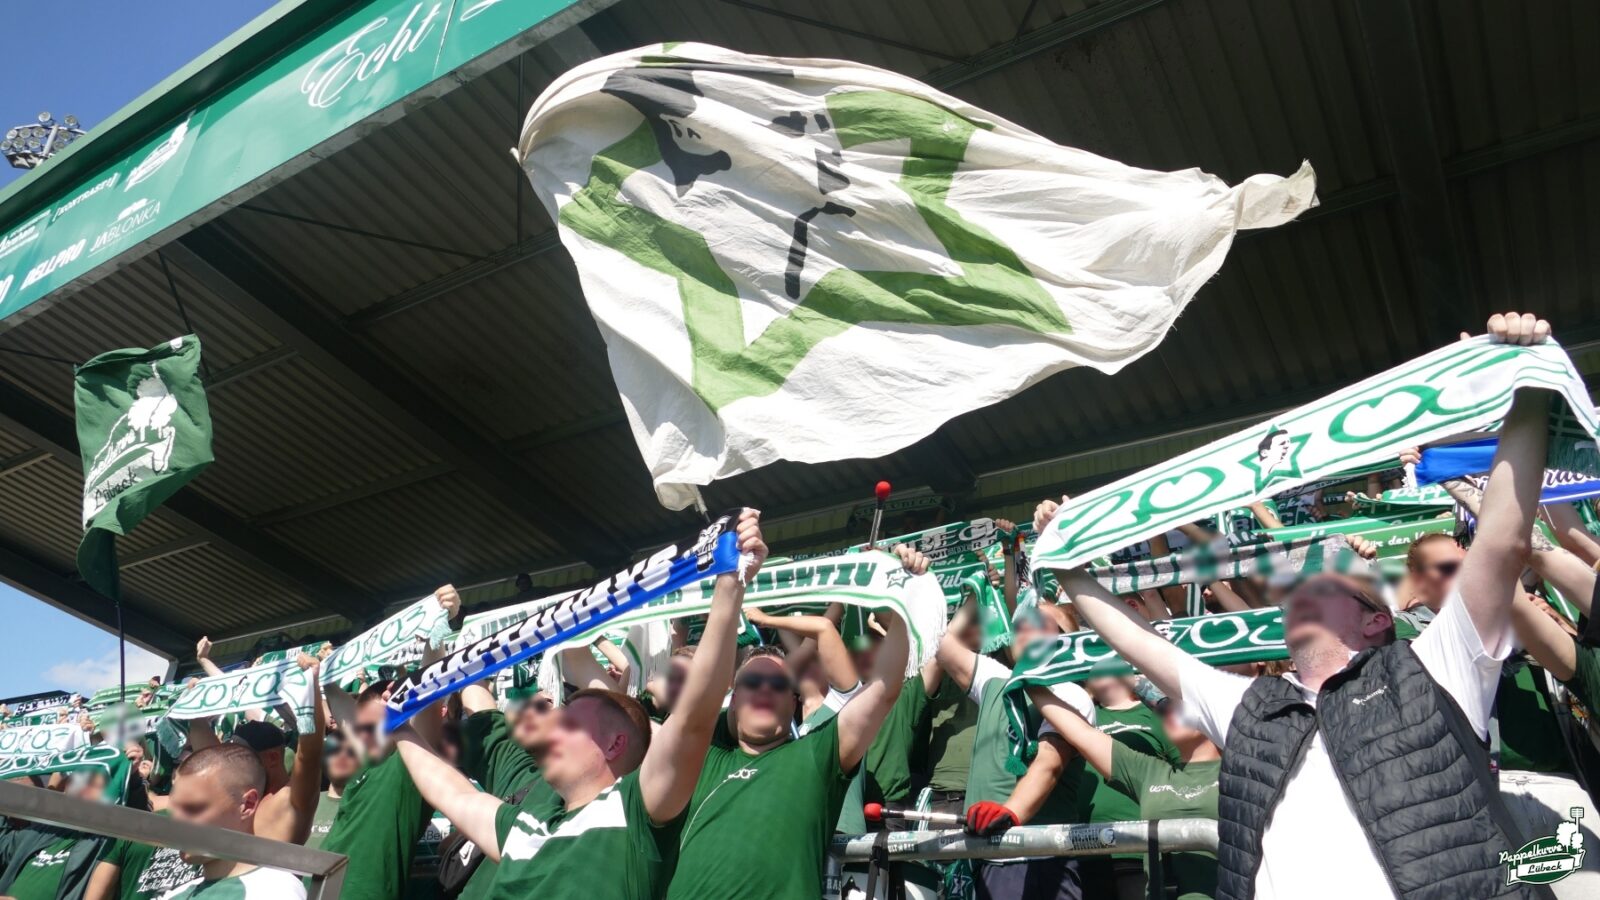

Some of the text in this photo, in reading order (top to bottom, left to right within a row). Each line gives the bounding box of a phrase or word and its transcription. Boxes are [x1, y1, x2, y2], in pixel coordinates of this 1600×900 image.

[301, 2, 441, 108] Echt
[90, 201, 161, 251] JABLONKA
[1388, 535, 1411, 546] den
